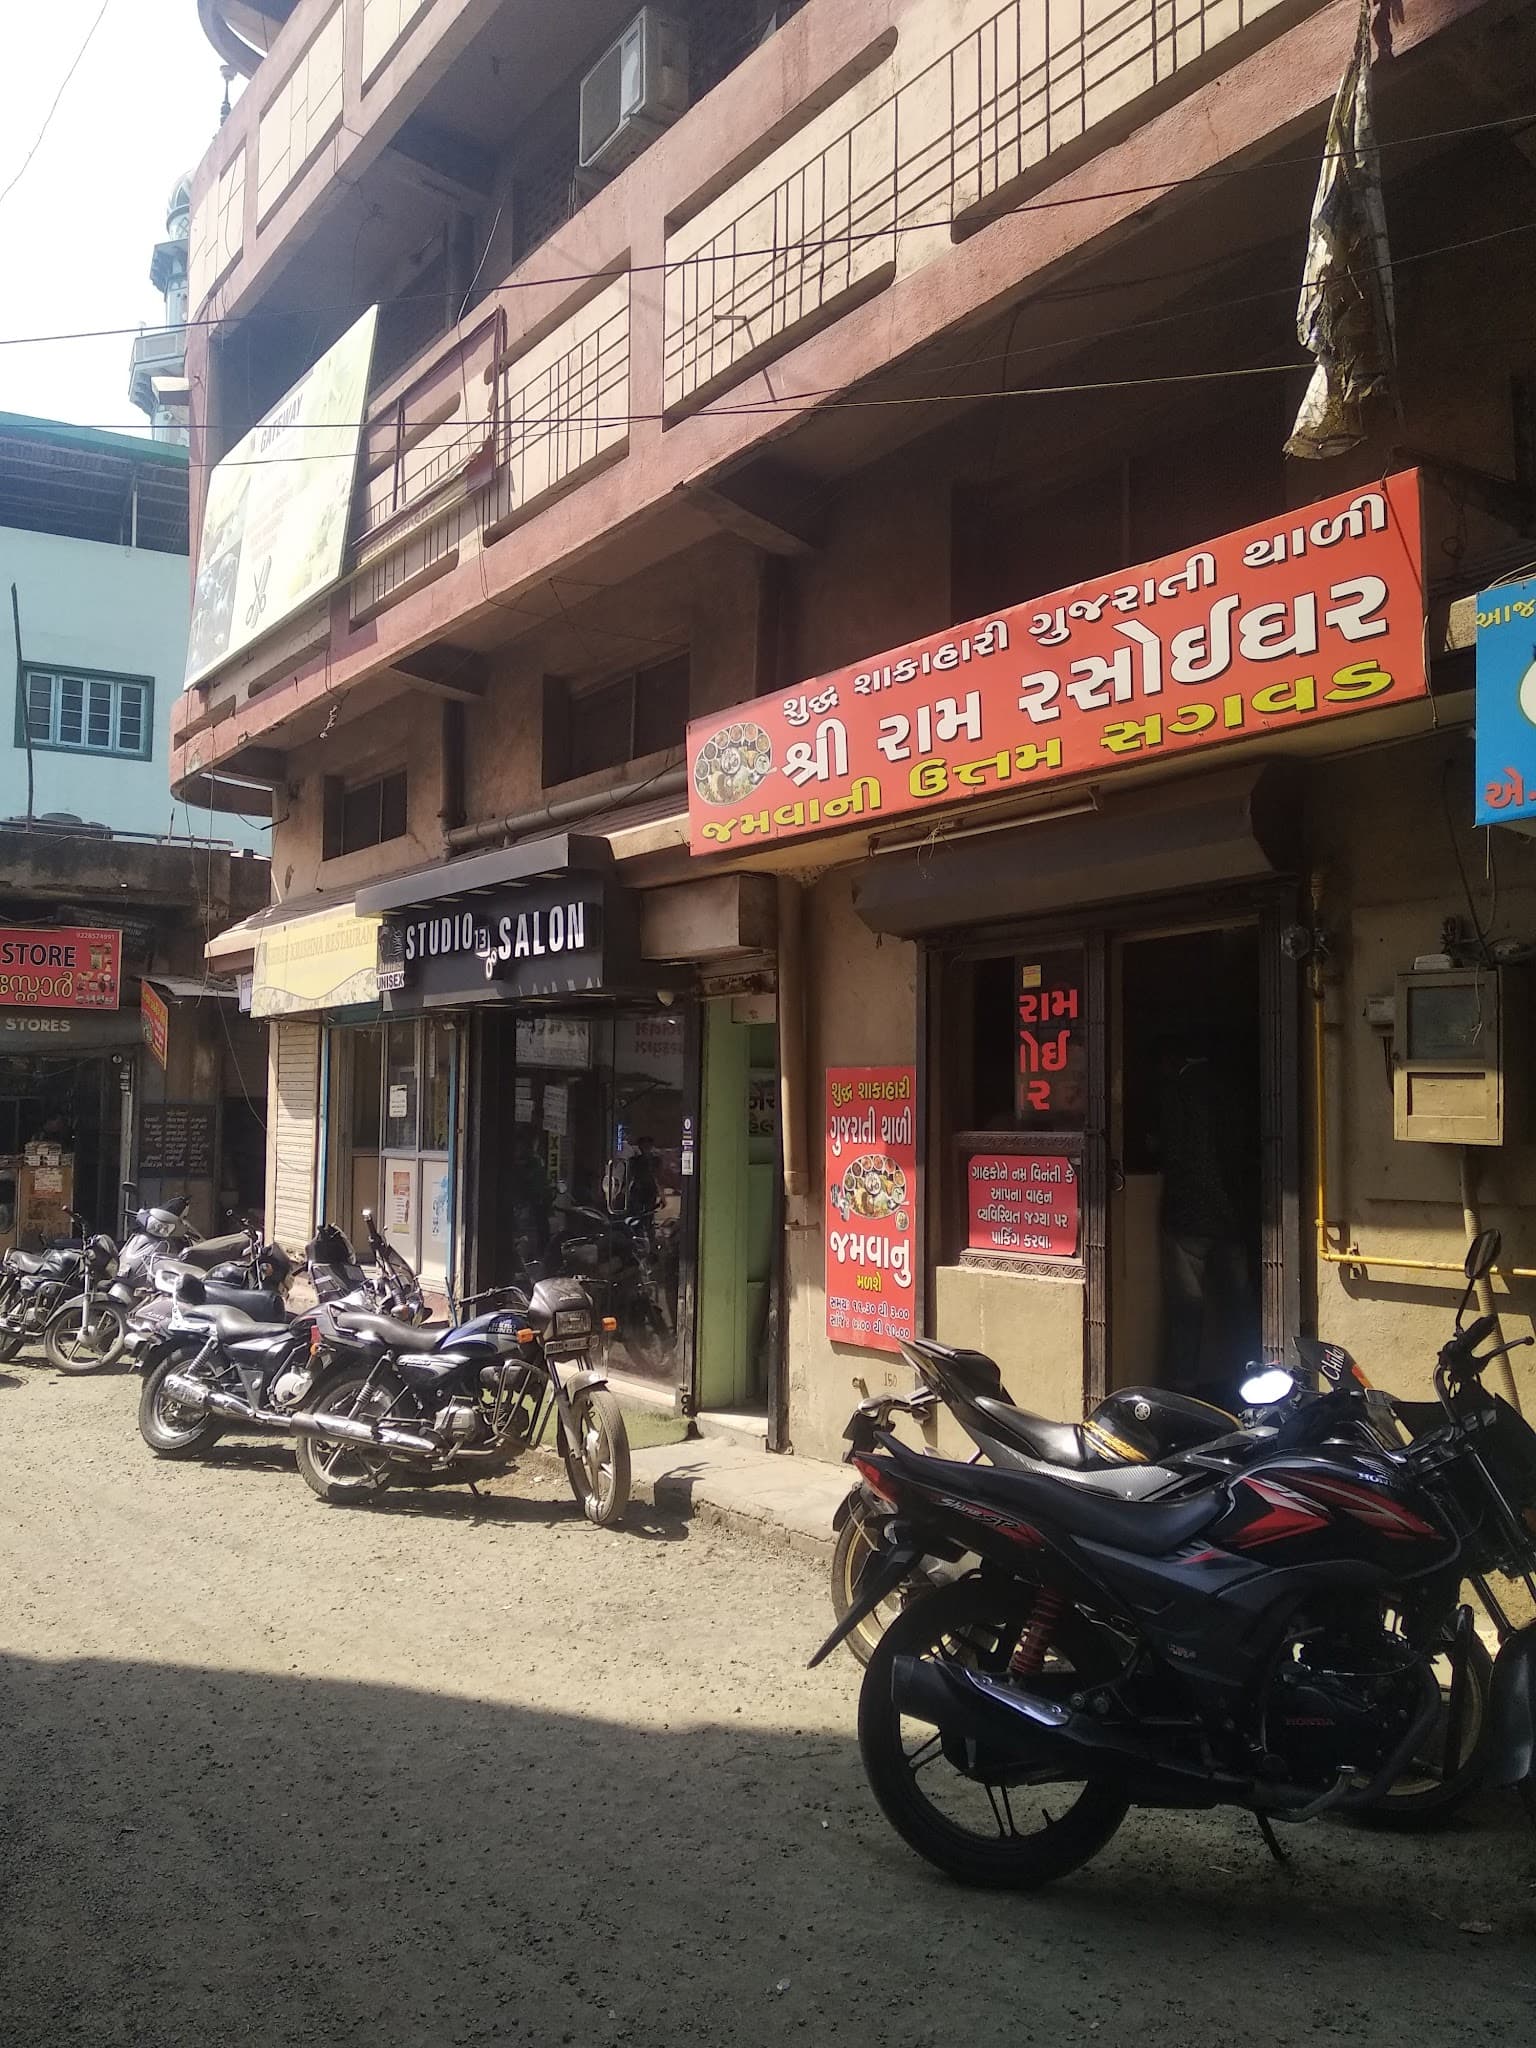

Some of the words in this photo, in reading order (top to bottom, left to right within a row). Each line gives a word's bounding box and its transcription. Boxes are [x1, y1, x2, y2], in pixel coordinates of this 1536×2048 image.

[782, 683, 838, 726] શુદ્ધ
[853, 621, 1009, 694] શાકાહારી
[1028, 552, 1216, 645] ગુજરાતી
[1242, 494, 1387, 567] થાળી
[782, 719, 849, 788] શ્રી
[877, 690, 982, 762] રામ
[1018, 575, 1388, 723] રસોઈઘર
[702, 776, 882, 842] જમવાની
[908, 736, 1062, 798] ઉત્તમ
[1100, 660, 1394, 753] સગવડ
[406, 912, 473, 961] STUDIO
[474, 927, 488, 951] 13
[499, 901, 585, 961] SALON
[2, 942, 76, 968] STORE
[377, 973, 404, 991] UNISEX
[1019, 989, 1078, 1022] રામ
[5, 1017, 71, 1032] STORES
[858, 1075, 910, 1100] શાકાહારી
[830, 1105, 876, 1156] ગુજરાતી
[881, 1105, 912, 1145] થાળી
[971, 1161, 1008, 1180] ગ્રાહકોને
[1031, 1162, 1061, 1183] વિનંતી
[1065, 1163, 1075, 1184] કે
[990, 1187, 1022, 1202] આપના
[1025, 1189, 1053, 1204] વાહન
[1024, 1211, 1050, 1227] જગ્યા
[1054, 1213, 1069, 1228] પર
[856, 1272, 882, 1292] મળશે
[877, 1300, 888, 1318] થી
